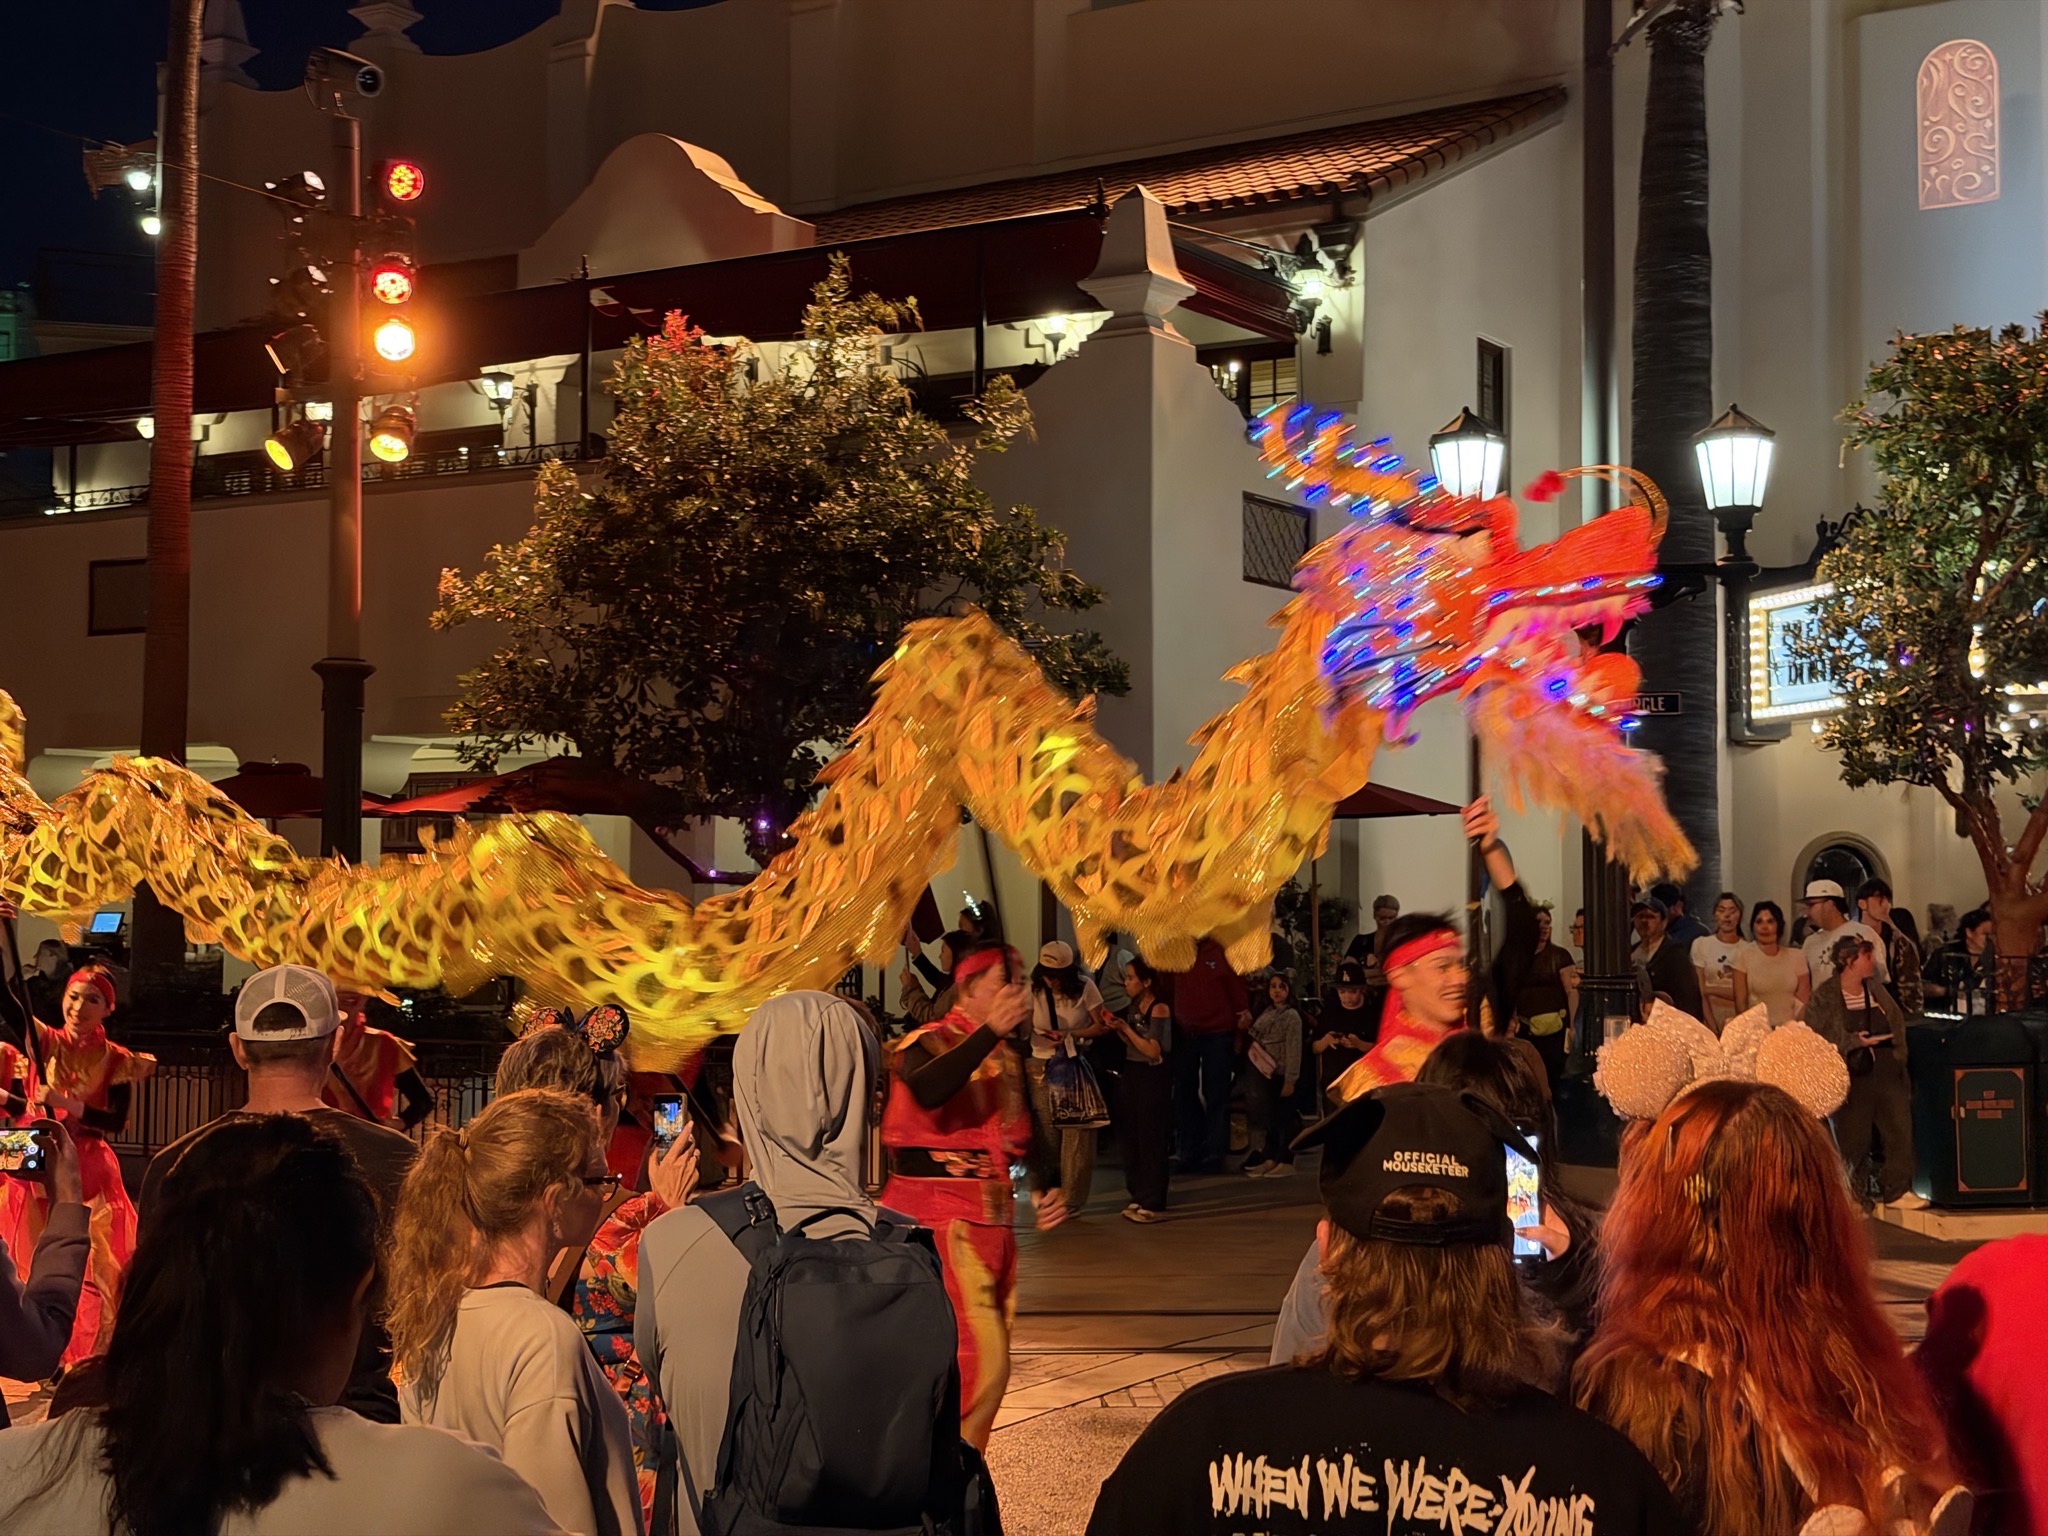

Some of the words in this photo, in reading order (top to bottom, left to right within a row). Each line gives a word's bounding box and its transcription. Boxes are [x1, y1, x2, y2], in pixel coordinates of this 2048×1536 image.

[1633, 696, 1665, 711] RCLE
[1393, 1151, 1460, 1166] OFFICIAL
[1382, 1159, 1470, 1178] MOUSEKETEER
[1209, 1452, 1310, 1518] WHEN
[1317, 1453, 1380, 1521] WE
[1384, 1456, 1494, 1536] WERE
[1494, 1465, 1596, 1536] YOUNG
